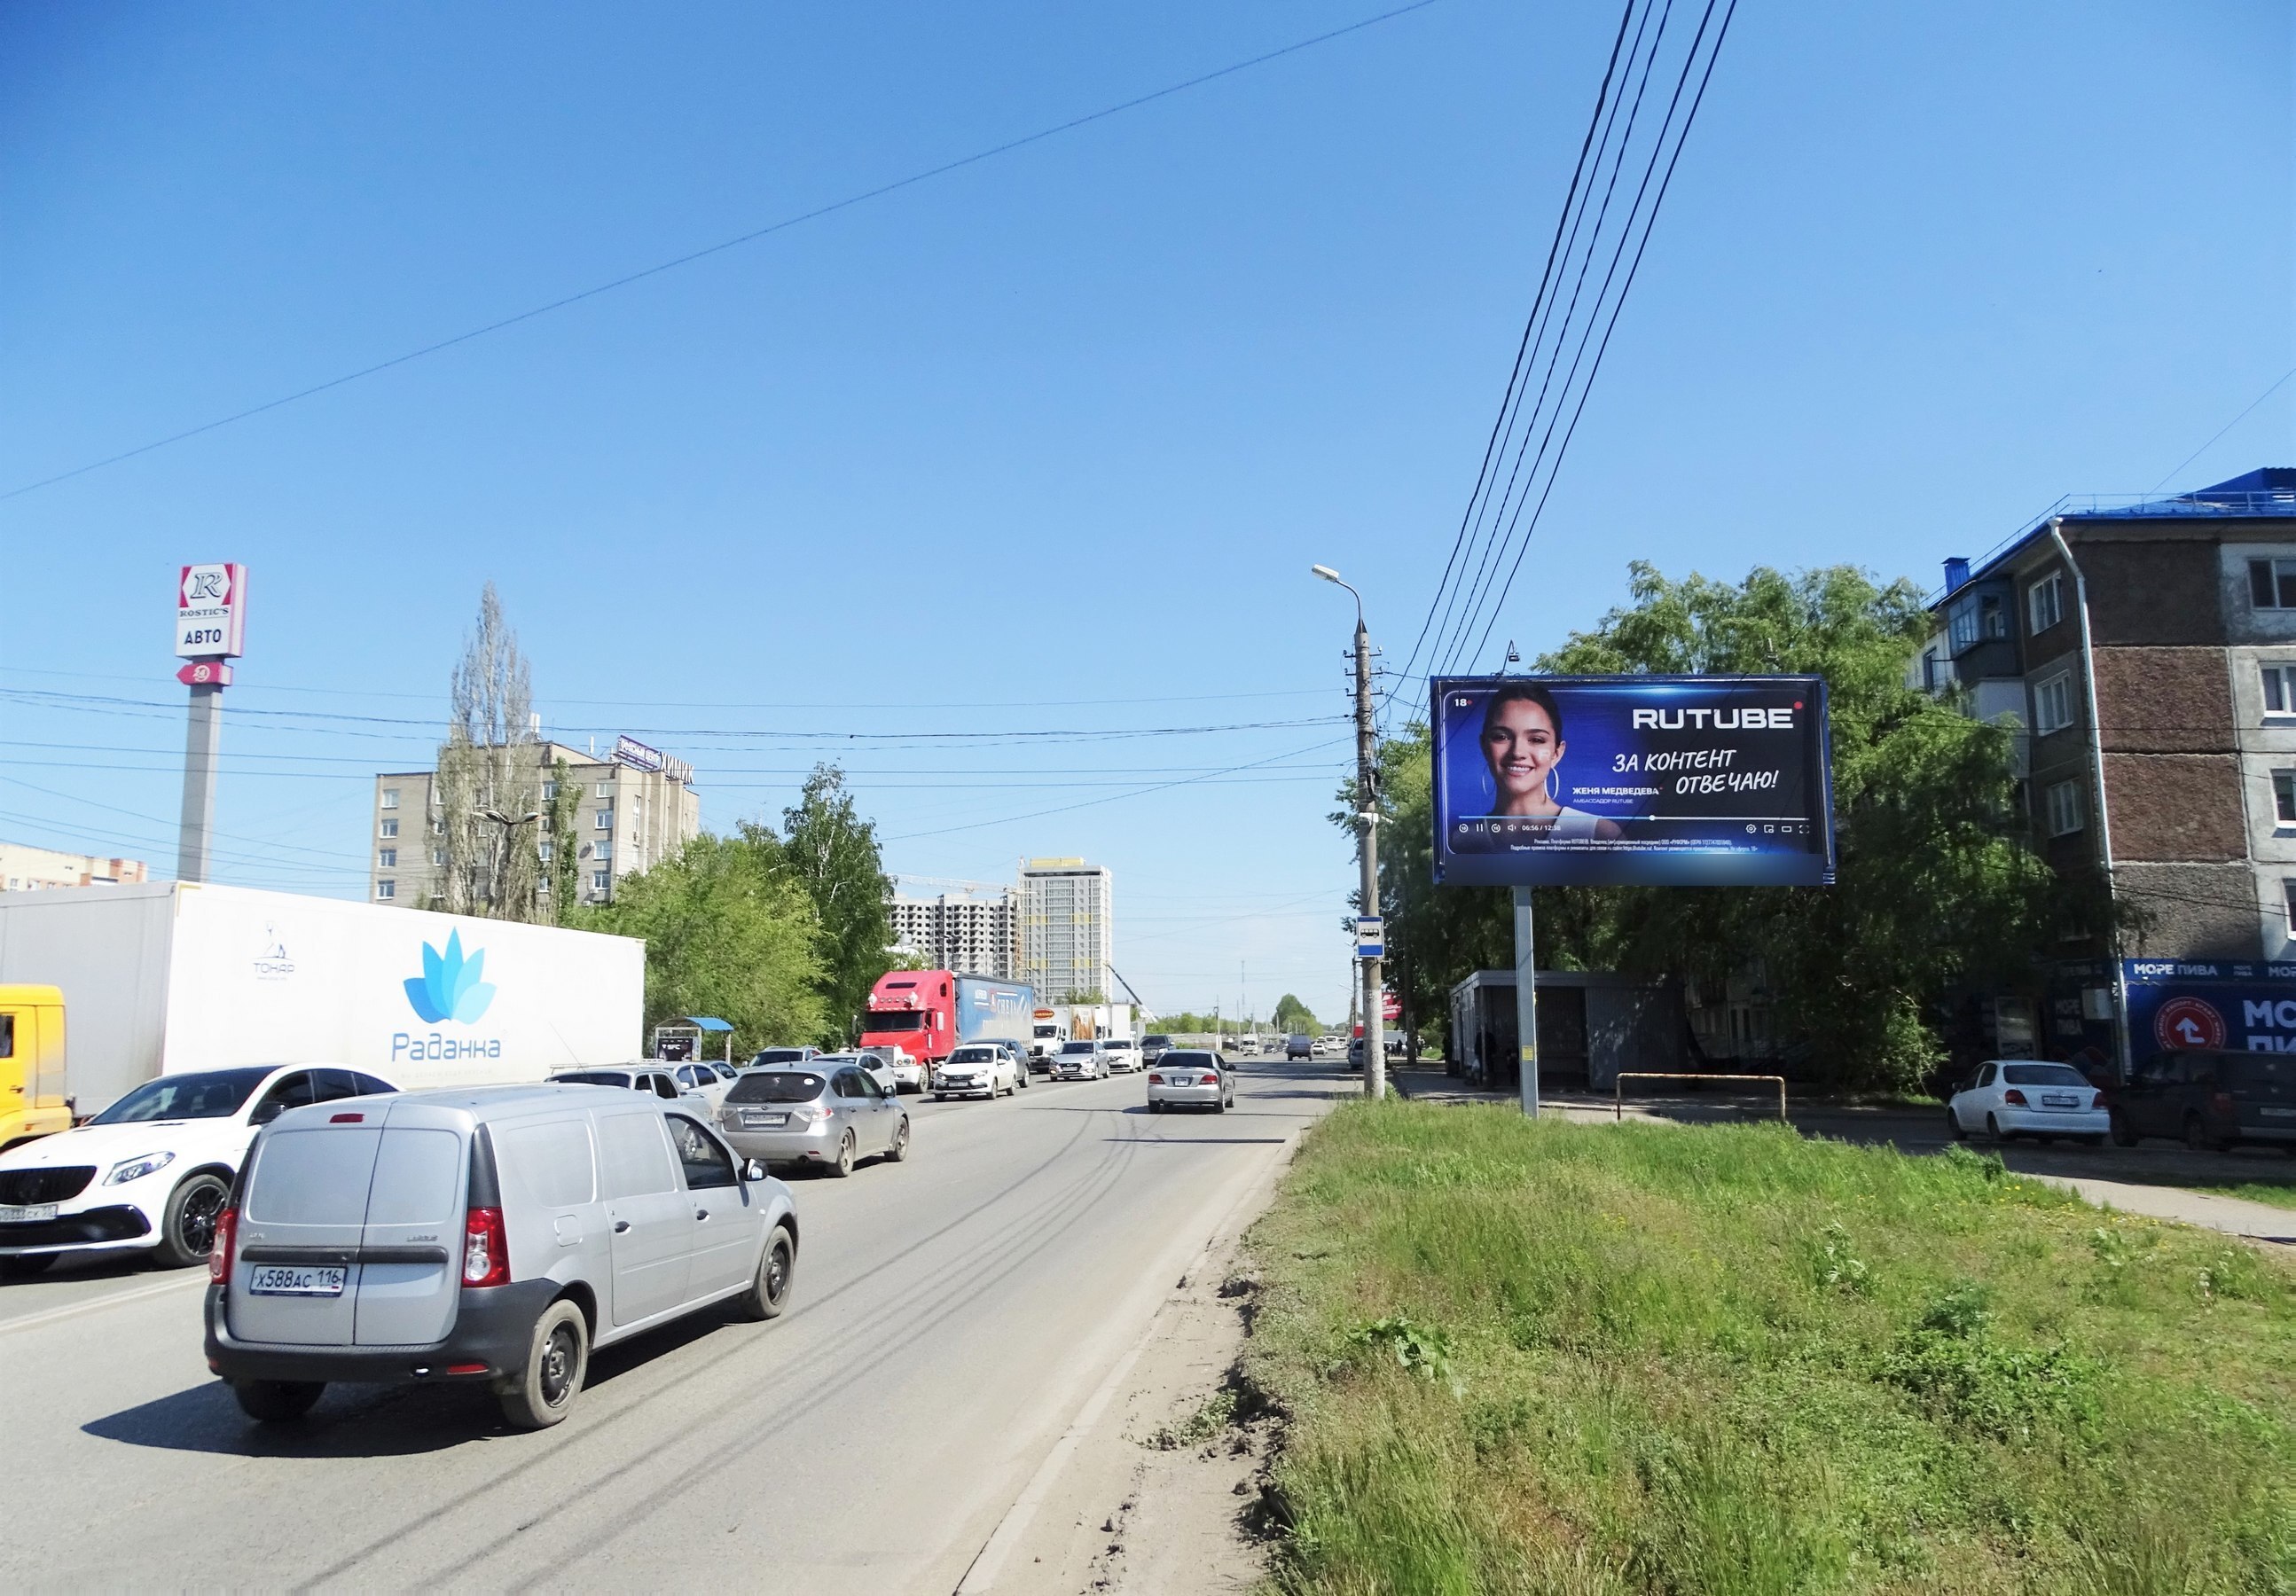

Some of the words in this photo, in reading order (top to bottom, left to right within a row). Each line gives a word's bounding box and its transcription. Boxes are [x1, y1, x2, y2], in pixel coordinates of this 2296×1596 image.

[179, 607, 230, 618] ROSTIC'S
[184, 629, 222, 645] АВТО
[1633, 708, 1794, 730] RUTUBE
[661, 752, 694, 786] ХИМИК
[1612, 754, 1639, 772] ЗА
[1644, 749, 1737, 771] КОНТЕНТ
[1602, 787, 1659, 796] МЕДВЕДЕВА
[1675, 770, 1780, 794] ОТВЕЧАЮ!
[253, 963, 295, 974] ТОНАР
[2134, 964, 2174, 975] МОРЕ
[2177, 965, 2218, 975] ПИВА
[392, 1033, 501, 1062] Раданка
[257, 1270, 312, 1288] Х588АС
[317, 1269, 340, 1284] 116
